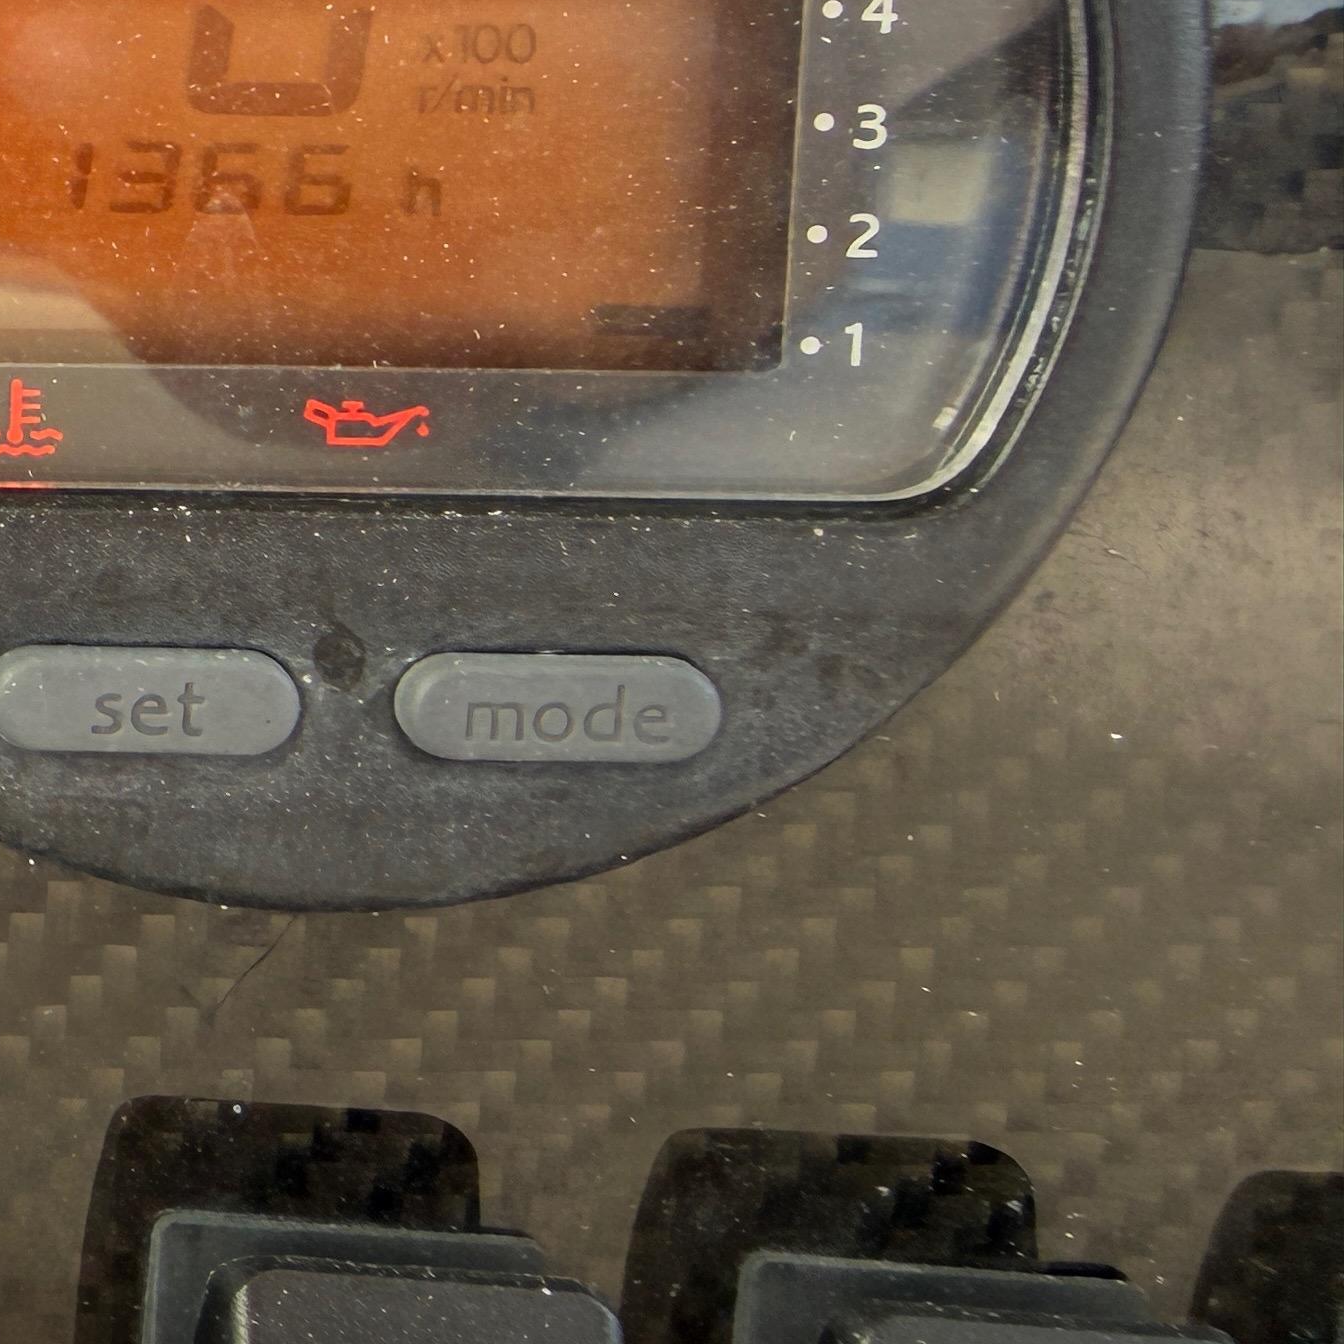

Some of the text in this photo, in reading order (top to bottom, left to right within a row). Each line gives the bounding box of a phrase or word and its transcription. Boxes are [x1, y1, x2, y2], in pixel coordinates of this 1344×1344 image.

[416, 74, 537, 116] r/min
[853, 105, 887, 151] 3
[69, 140, 353, 217] 1366
[846, 213, 880, 258] 2
[842, 323, 863, 368] 1
[89, 681, 206, 739] set
[464, 684, 671, 747] mode
